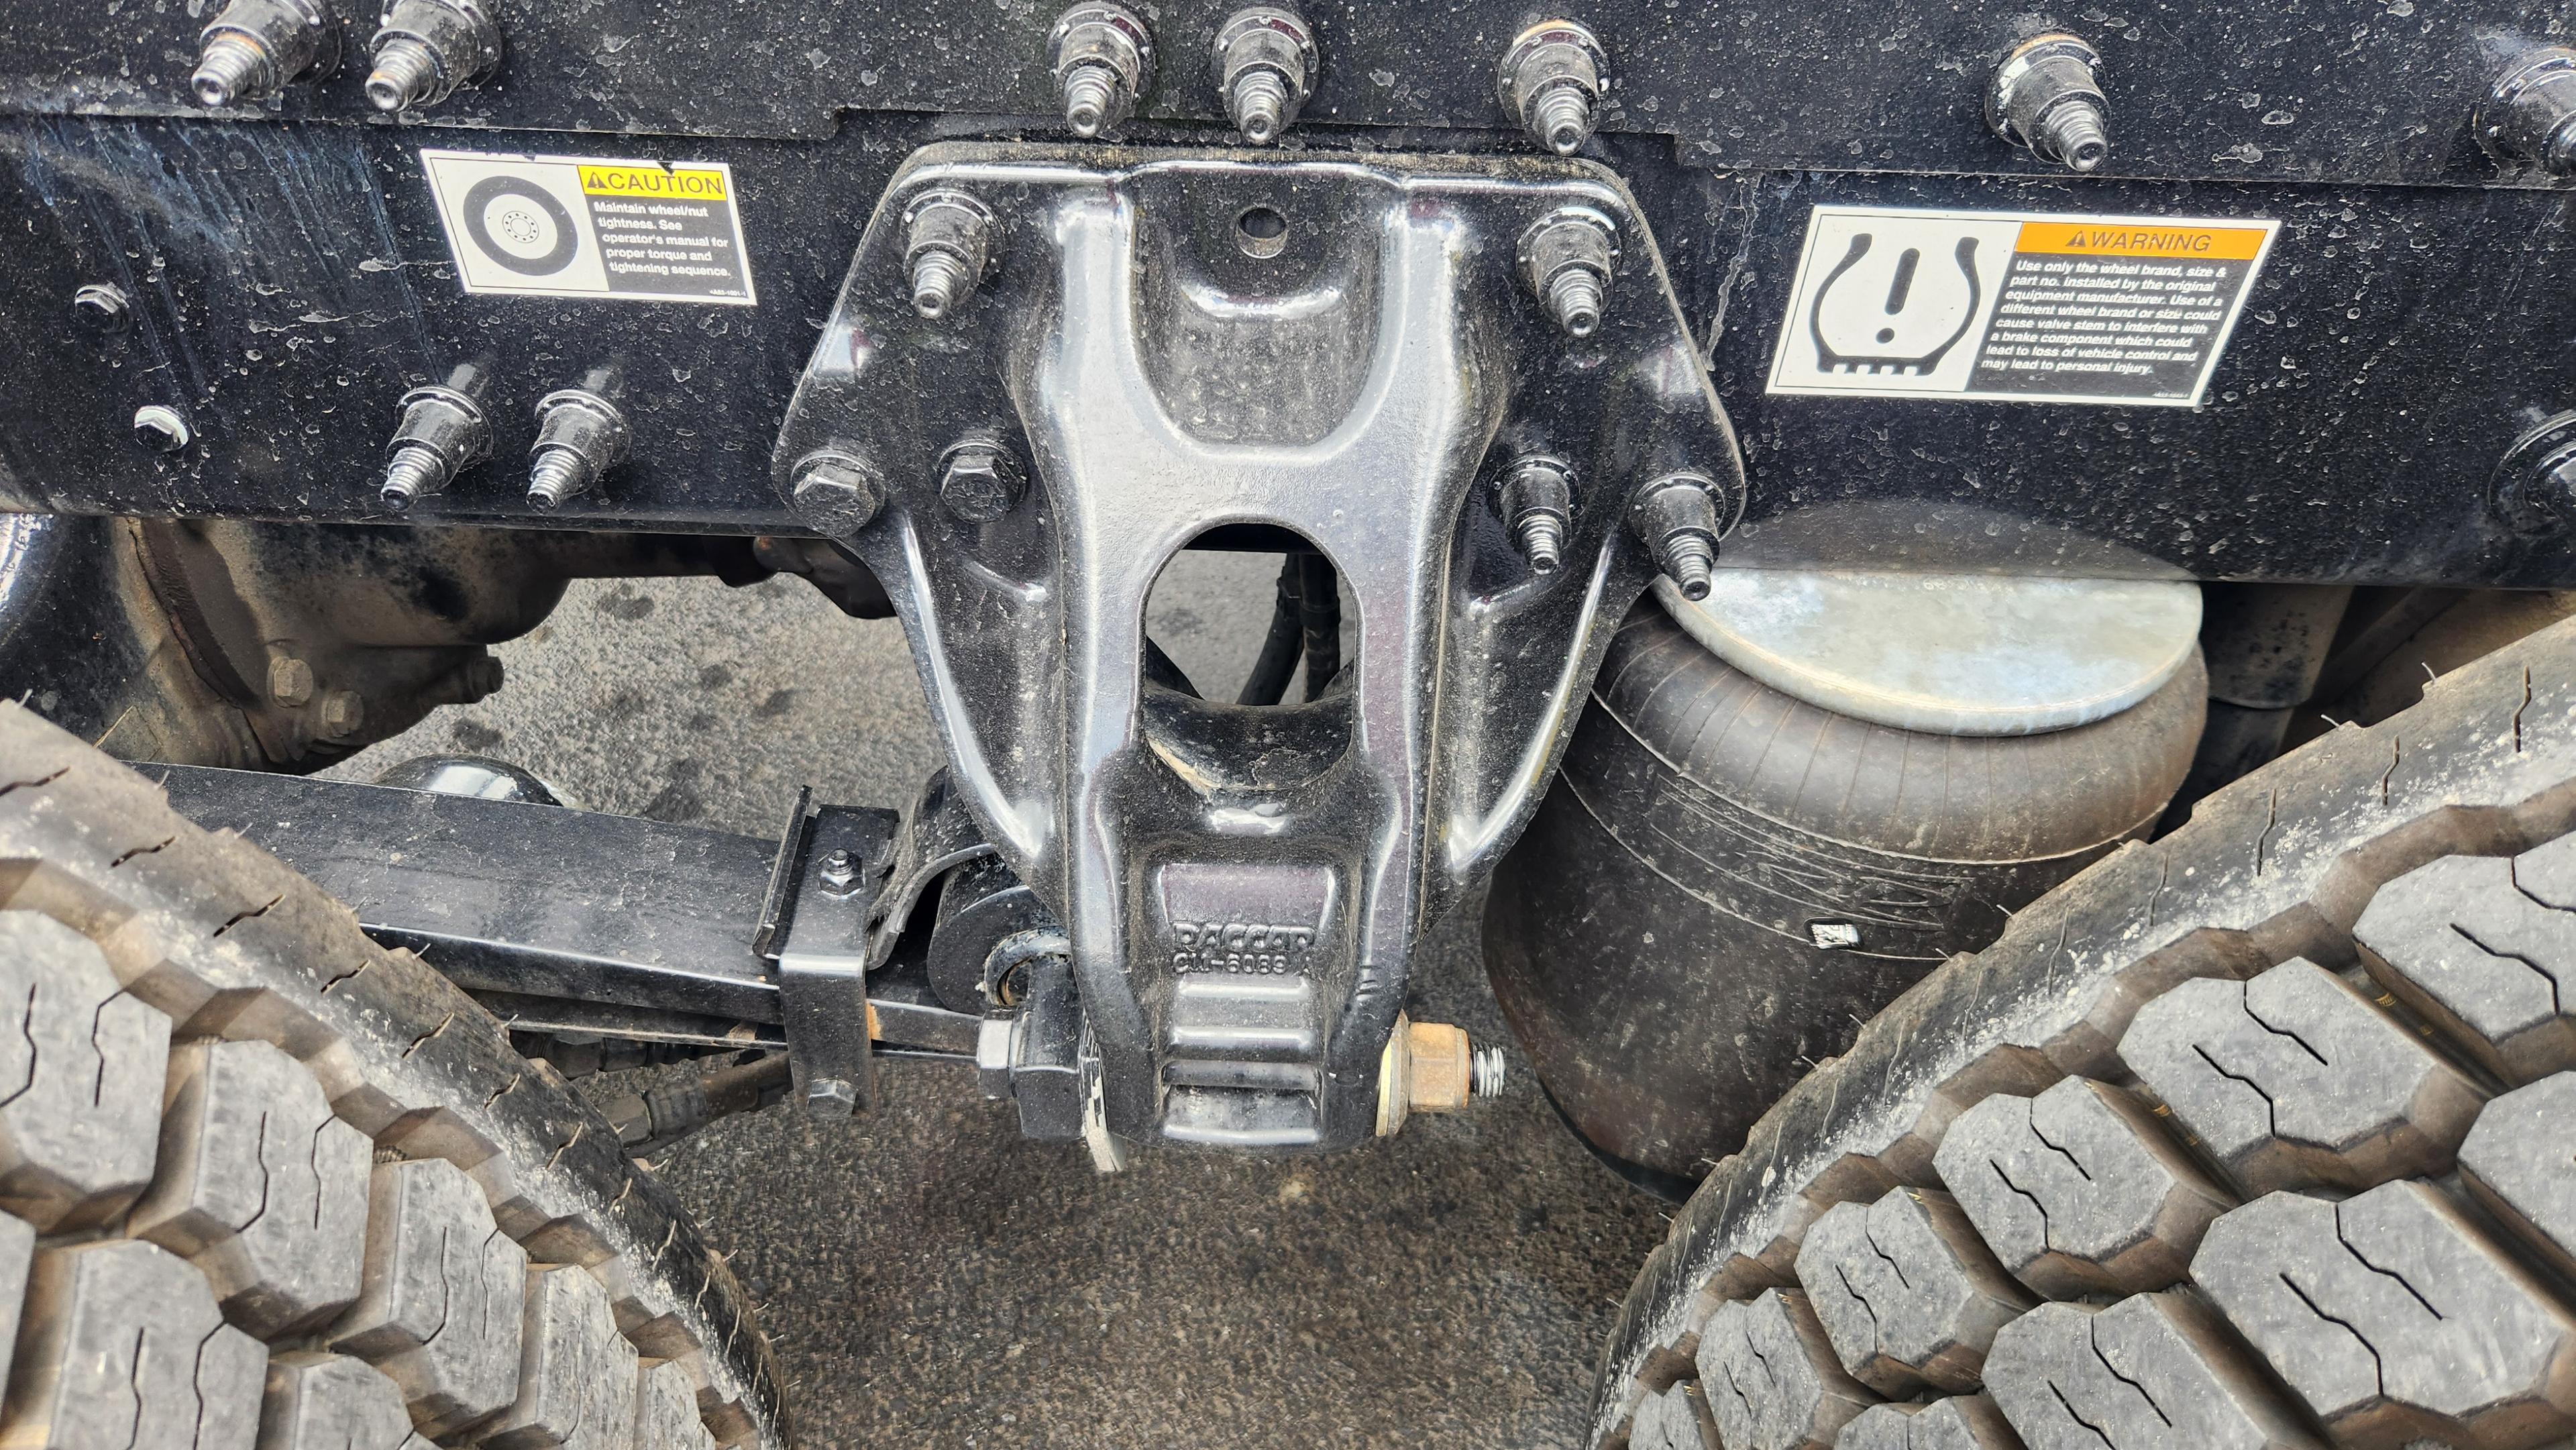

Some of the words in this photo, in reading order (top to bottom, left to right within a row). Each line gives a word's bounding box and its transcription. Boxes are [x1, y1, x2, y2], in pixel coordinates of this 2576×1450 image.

[608, 172, 722, 195] CAUTION
[594, 201, 646, 214] Maintain
[648, 205, 709, 217] wheel/nut
[598, 217, 657, 230] tightness.
[658, 219, 683, 231] See
[602, 234, 663, 245] operator's
[665, 236, 709, 246] manual
[711, 237, 729, 248] for
[2091, 231, 2212, 252] WARNING
[606, 248, 645, 260] proper
[647, 249, 688, 262] torque
[690, 251, 712, 262] and
[609, 261, 669, 275] tightening
[671, 265, 731, 277] sequence.
[2016, 260, 2042, 272] Use
[2044, 260, 2075, 275] only
[2076, 261, 2098, 273] the
[2100, 262, 2140, 275] wheel
[2141, 264, 2183, 278] brand,
[2186, 266, 2214, 277] size
[2216, 267, 2226, 278] &
[2008, 275, 2039, 288] part
[2039, 277, 2060, 287] no.
[2063, 276, 2121, 289] installed
[2122, 278, 2140, 292] by
[2141, 278, 2163, 291] the
[2165, 280, 2217, 293] original
[2005, 289, 2076, 302] equipment
[2169, 294, 2196, 305] Use
[2198, 296, 2213, 306] of
[2213, 297, 2223, 307] a
[2000, 303, 2056, 315] different
[2057, 305, 2097, 316] wheel
[2097, 306, 2138, 317] brand
[2138, 309, 2155, 318] or
[2155, 308, 2182, 319] size
[2184, 310, 2222, 320] could
[1996, 319, 2035, 328] cause
[2037, 318, 2072, 329] valve
[2073, 320, 2106, 330] stem
[2107, 321, 2123, 331] to
[2123, 321, 2178, 333] interfere
[2180, 323, 2208, 334] with
[1990, 333, 2000, 342] a
[2001, 331, 2039, 342] brake
[2040, 333, 2113, 346] component
[2114, 335, 2154, 346] which
[2155, 338, 2193, 347] could
[1986, 344, 2015, 355] lead
[2015, 346, 2030, 356] to
[2031, 346, 2060, 356] loss
[2061, 346, 2078, 357] of
[2078, 347, 2124, 358] vehicle
[2125, 350, 2171, 360] control
[2171, 351, 2199, 361] and
[1981, 359, 2008, 370] may
[2010, 358, 2039, 369] lead
[2040, 360, 2054, 370] to
[2055, 361, 2113, 372] personal
[2113, 363, 2153, 375] injury.
